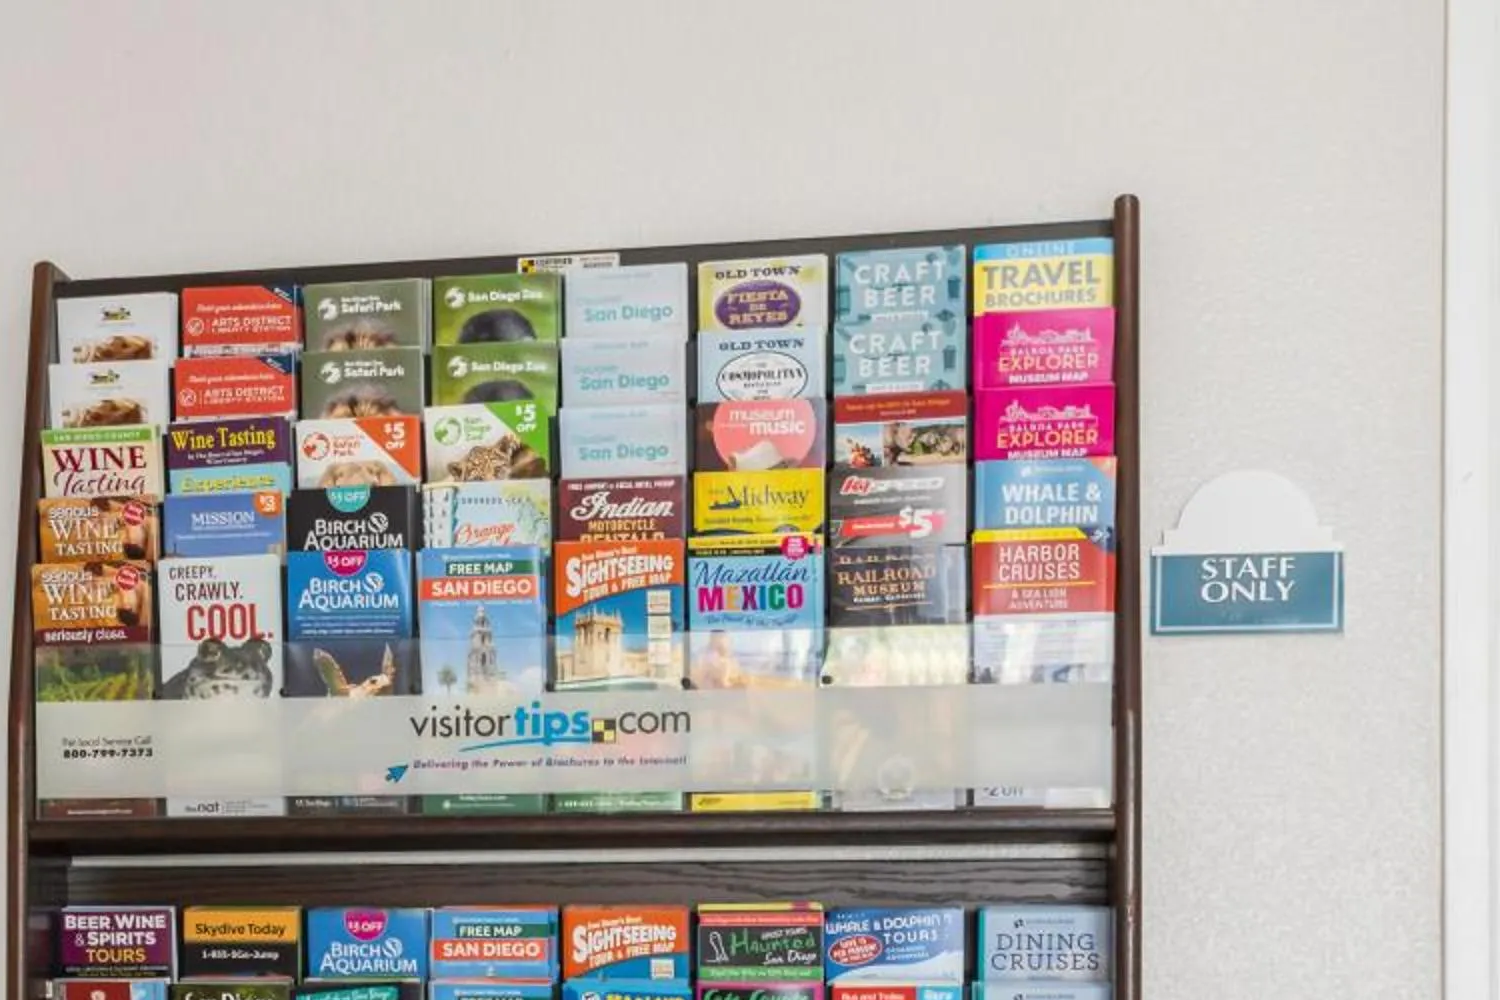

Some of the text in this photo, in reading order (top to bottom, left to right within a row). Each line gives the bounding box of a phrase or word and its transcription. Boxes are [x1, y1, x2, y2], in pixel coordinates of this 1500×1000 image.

[854, 261, 946, 284] CRAFT
[983, 260, 1100, 290] TRAVEL
[864, 284, 936, 308] BEER
[985, 287, 1097, 308] BROCHURES
[212, 315, 292, 327] ARTS DISTRICT
[850, 331, 943, 354] CRAFT
[858, 357, 931, 378] BEER
[999, 353, 1099, 372] EXPLORER
[1009, 372, 1089, 384] MUSEUM MAP
[205, 385, 284, 399] ARTS DISTRICT
[729, 407, 796, 422] museum
[749, 418, 805, 436] music
[172, 426, 275, 451] Wine Tasting
[997, 429, 1098, 449] EXPLORER
[52, 446, 147, 473] WINE
[1007, 449, 1057, 460] MUSEUM
[726, 483, 809, 509] Midway
[1003, 481, 1101, 503] WHALE &
[571, 491, 674, 521] Indian
[1005, 504, 1098, 525] DOLPHIN
[191, 511, 255, 526] MISSION
[316, 519, 365, 535] BIRCH
[55, 540, 123, 557] TASTING
[304, 532, 403, 551] AQUARIUM
[999, 544, 1080, 562] HARBOR
[450, 561, 514, 574] FREE MAP
[566, 552, 675, 597] SIGHTSEEING
[693, 559, 809, 587] Mazatlán
[837, 565, 936, 585] RAILROAD
[999, 562, 1080, 581] CRUISES
[1201, 557, 1296, 580] STAFF
[175, 581, 244, 601] CRAWLY.
[310, 577, 361, 595] BIRCH
[432, 579, 532, 597] SAN DIEGO
[853, 582, 925, 597] MUSEUM
[1201, 580, 1295, 603] ONLY
[298, 593, 399, 611] AQUARIUM
[697, 583, 804, 612] MEXICO
[49, 606, 117, 621] TASTING
[187, 603, 274, 641] COOL.
[63, 748, 153, 759] 800-799-7373
[414, 755, 600, 770] Delivering Power Brochures
[88, 931, 157, 946] SPIRITS
[195, 922, 286, 937] Skydive Today
[460, 925, 523, 938] FREE MAP
[331, 941, 380, 958] BIRCH
[443, 941, 540, 957] SAN DIEGO
[573, 921, 676, 963] SIGHTSEEING
[996, 934, 1094, 951] DINING
[85, 949, 146, 963] TOURS
[320, 956, 418, 974] AQUARIUM
[991, 952, 1100, 971] CRUISES
